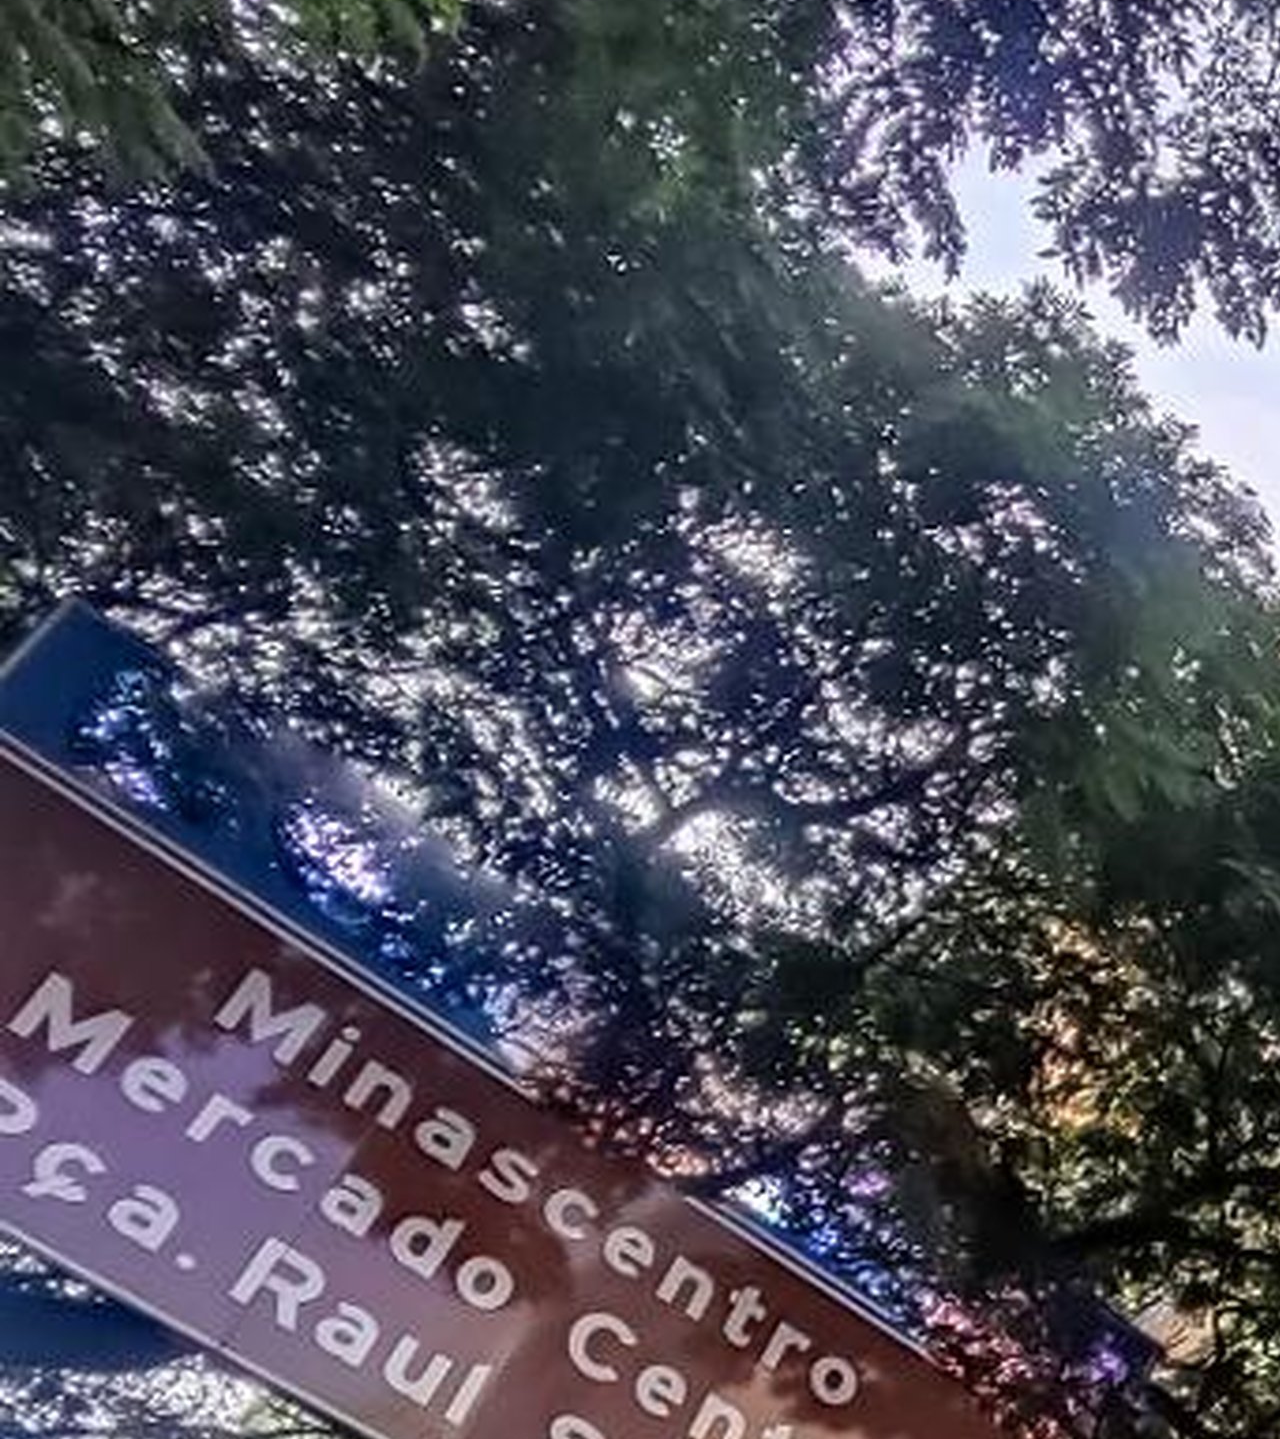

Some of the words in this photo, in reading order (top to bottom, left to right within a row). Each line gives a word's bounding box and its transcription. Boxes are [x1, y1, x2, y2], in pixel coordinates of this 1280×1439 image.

[8, 972, 514, 1311] Mercado
[213, 968, 858, 1405] Minascentro
[227, 1236, 492, 1428] Raul
